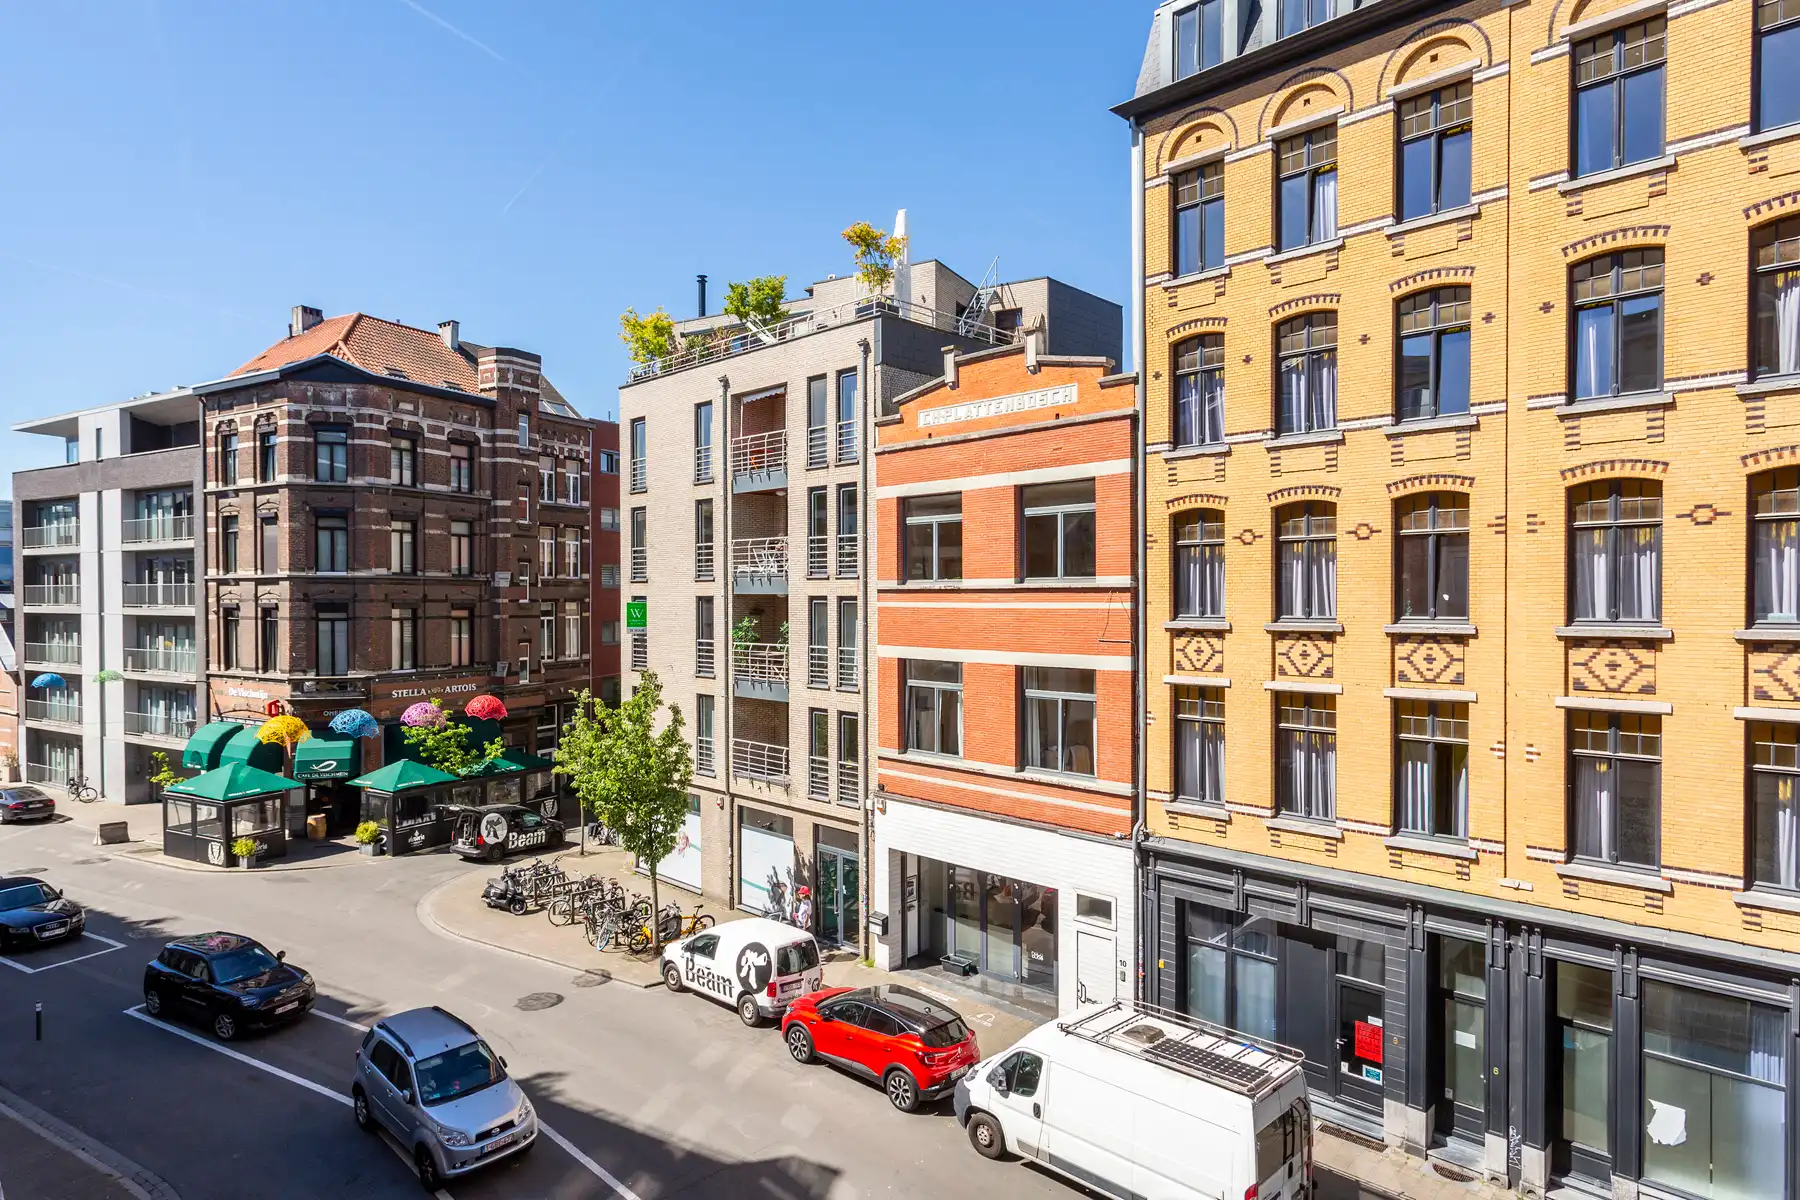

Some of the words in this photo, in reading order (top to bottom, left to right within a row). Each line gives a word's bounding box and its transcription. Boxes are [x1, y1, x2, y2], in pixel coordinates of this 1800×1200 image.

[391, 688, 427, 699] STELLA
[444, 683, 477, 694] ARTOIS
[508, 829, 546, 849] Beam
[1119, 959, 1127, 968] 10
[685, 956, 735, 999] Beam
